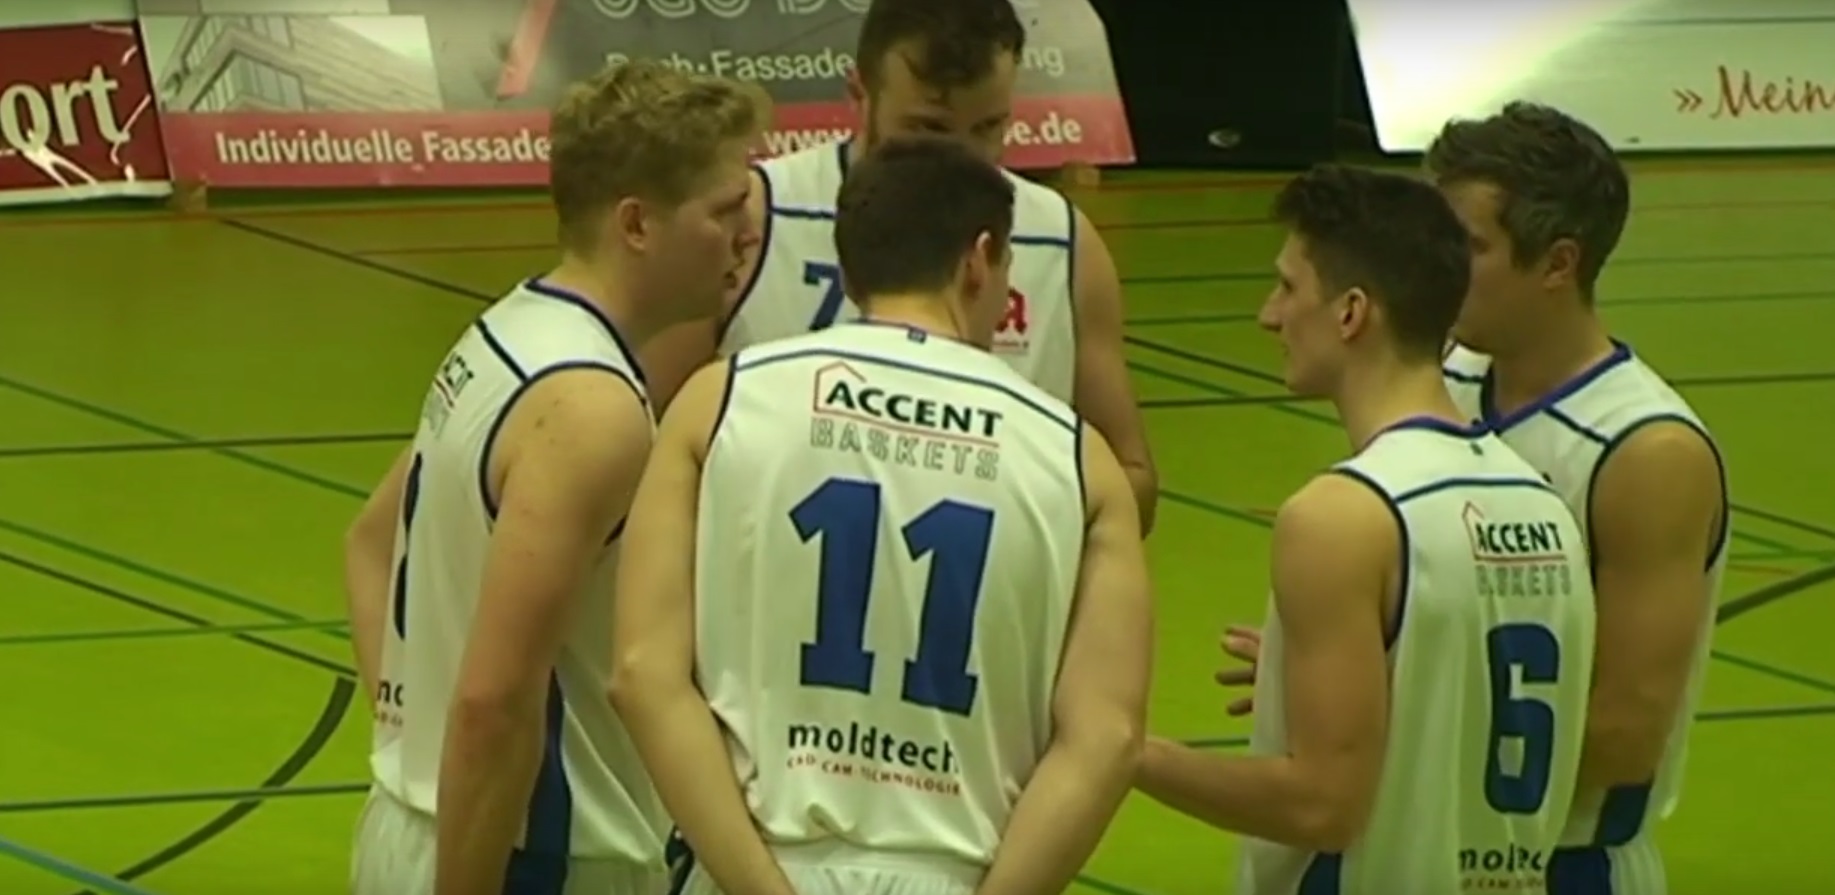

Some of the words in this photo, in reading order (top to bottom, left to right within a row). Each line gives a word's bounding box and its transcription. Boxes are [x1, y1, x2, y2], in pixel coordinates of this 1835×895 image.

[215, 128, 413, 163] Individuelle
[825, 380, 1003, 437] ACCENT
[810, 416, 999, 481] BASKETS
[1475, 521, 1563, 554] ACCENT
[789, 477, 995, 717] 11
[1484, 622, 1560, 815] 6
